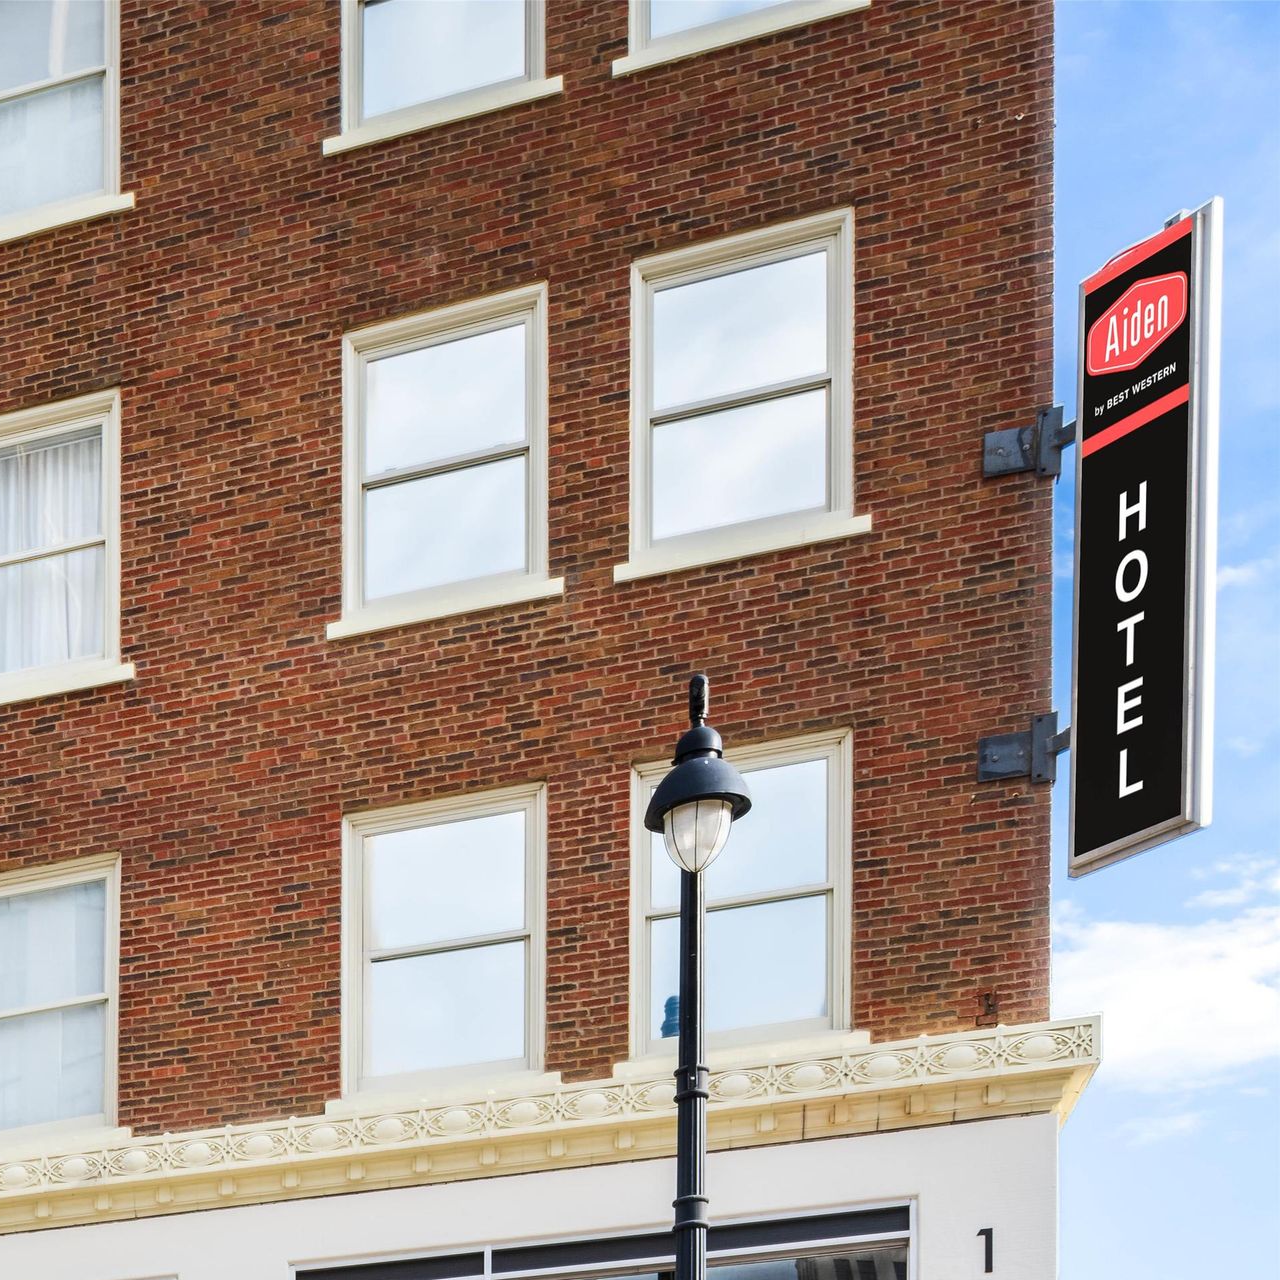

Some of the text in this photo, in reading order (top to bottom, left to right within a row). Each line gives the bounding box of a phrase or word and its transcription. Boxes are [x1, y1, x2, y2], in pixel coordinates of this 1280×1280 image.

[1105, 294, 1169, 363] Aiden
[1094, 362, 1177, 417] by BEST WESTERN
[1116, 479, 1149, 800] HOTEL
